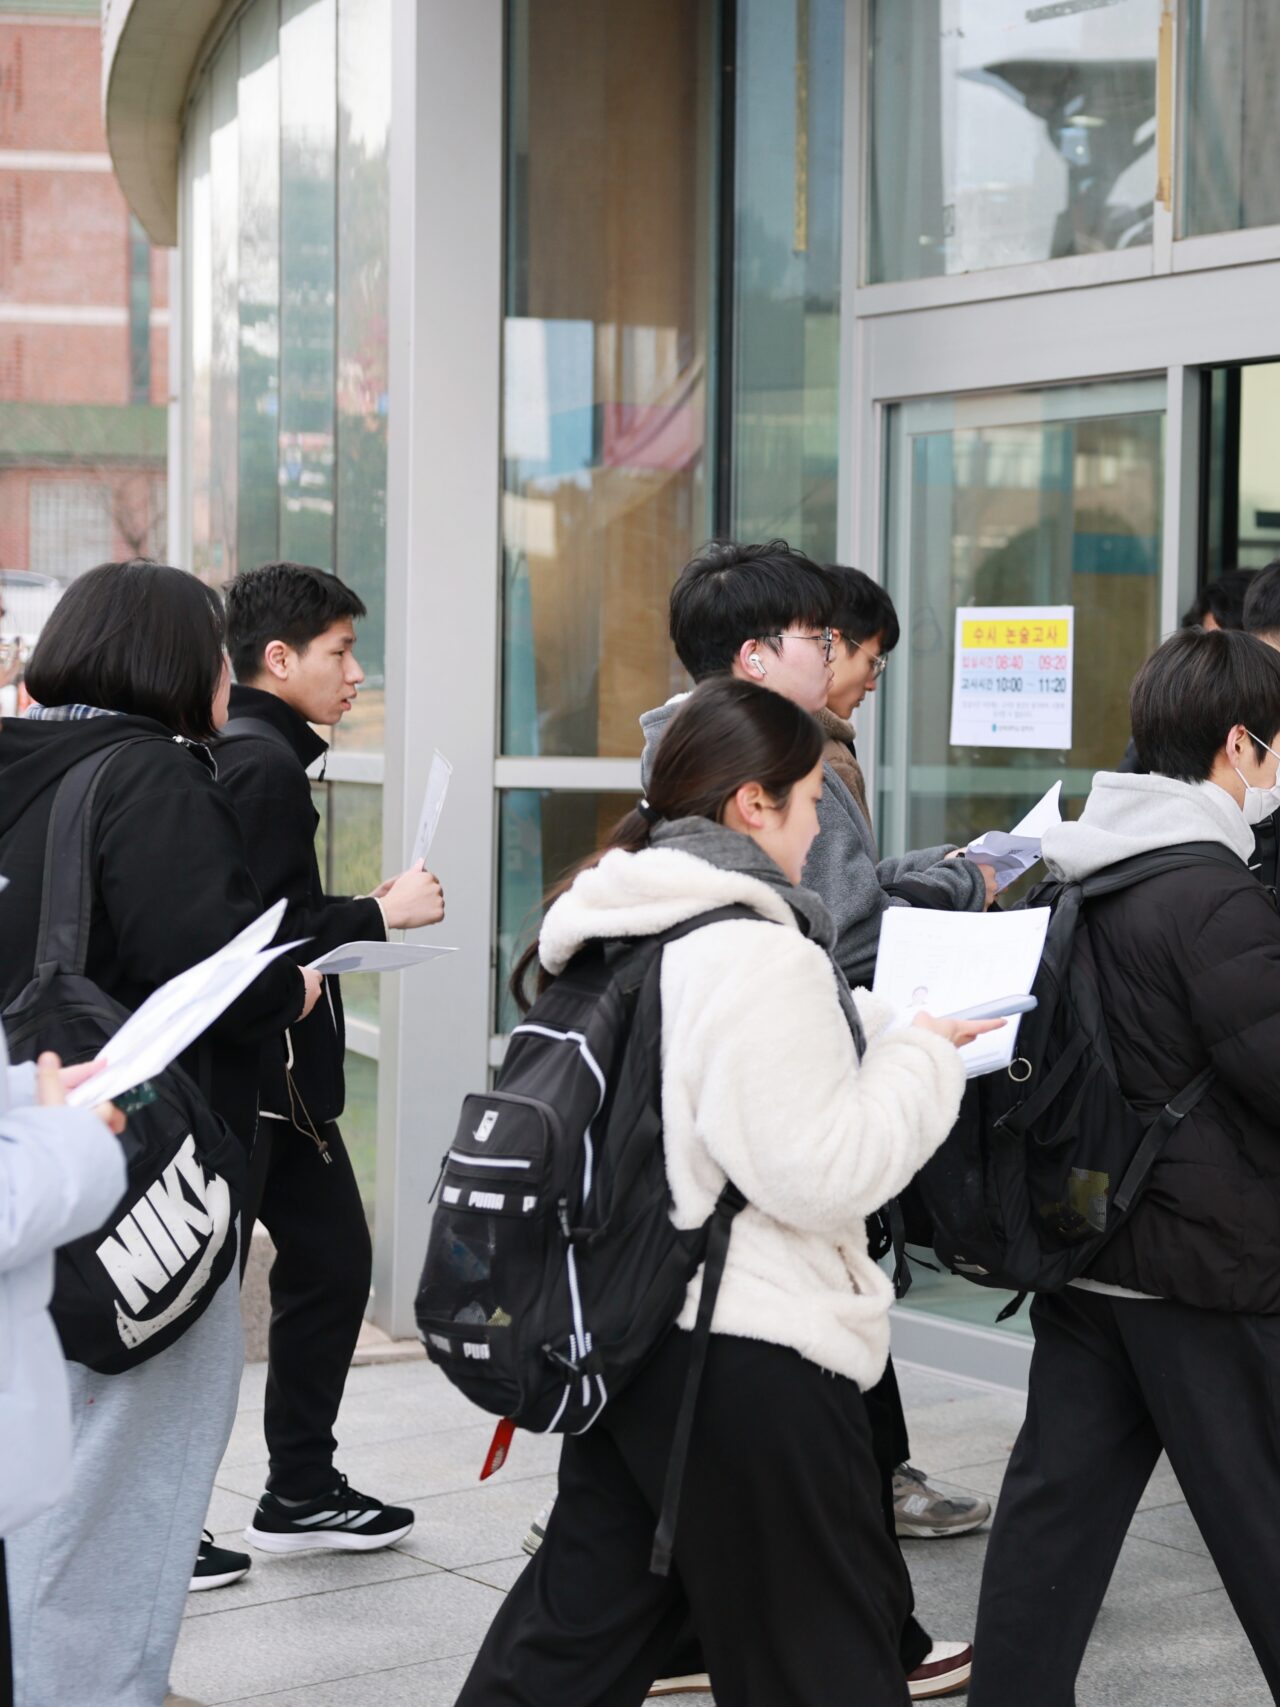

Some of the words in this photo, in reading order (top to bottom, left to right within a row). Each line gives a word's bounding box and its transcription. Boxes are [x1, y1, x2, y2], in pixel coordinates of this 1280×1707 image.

[974, 627, 997, 644] 수시
[1006, 626, 1058, 644] 논술고사
[996, 655, 1023, 670] 08:40
[1039, 655, 1067, 670] 09:20
[996, 677, 1023, 693] 10:00
[1039, 677, 1067, 693] 11:20
[96, 1133, 214, 1315] NIK
